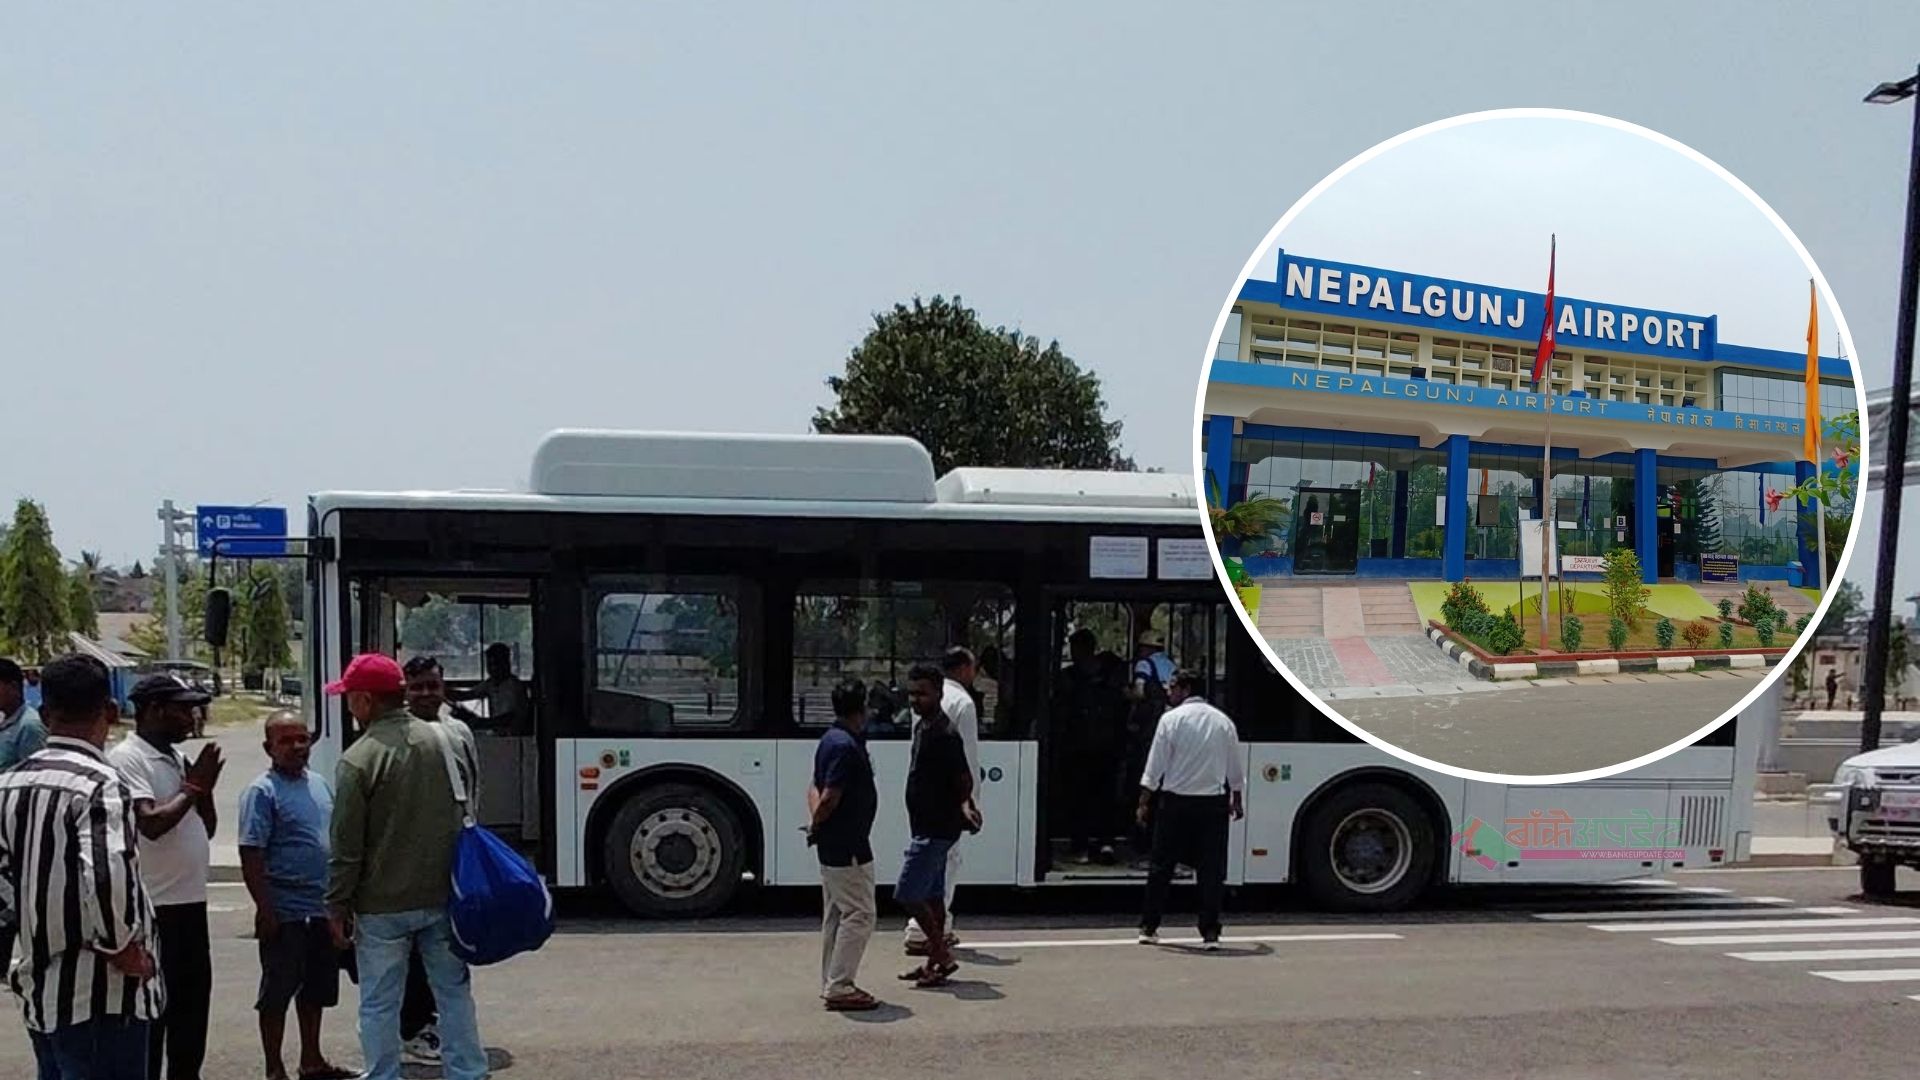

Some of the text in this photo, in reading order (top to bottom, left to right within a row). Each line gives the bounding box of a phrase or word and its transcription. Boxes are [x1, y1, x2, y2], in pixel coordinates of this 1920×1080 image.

[1286, 263, 1704, 350] NEPALGUNJ AIRPORT
[1292, 372, 1608, 414] NEPALGUNJ AIRPORT
